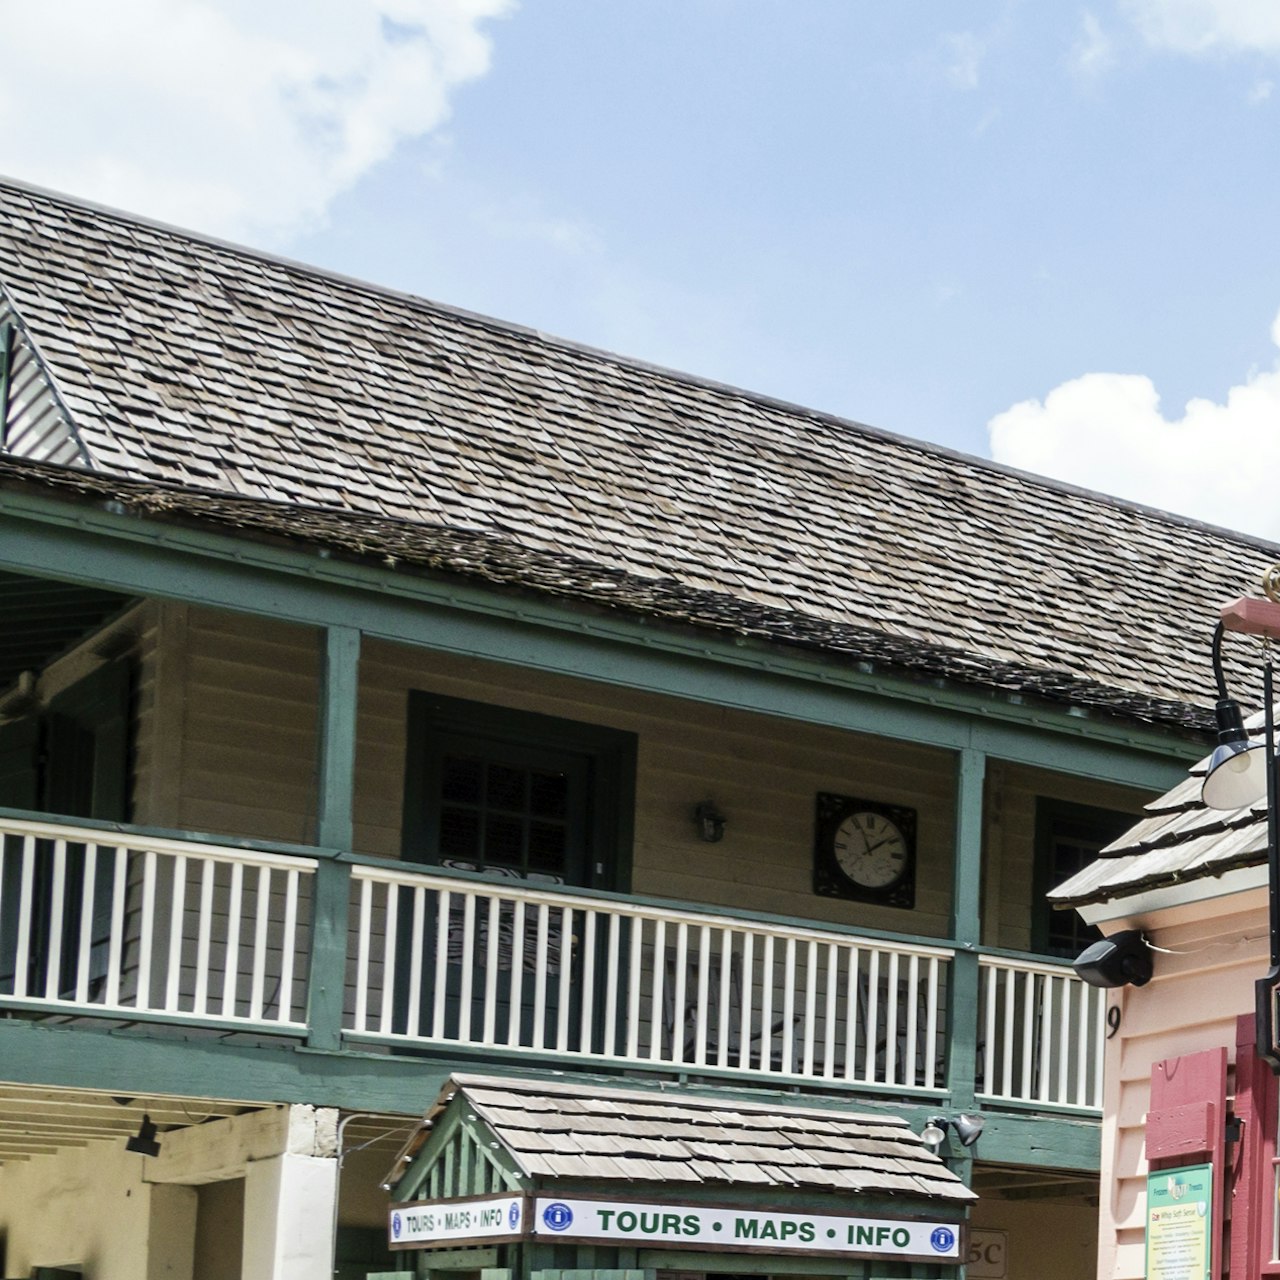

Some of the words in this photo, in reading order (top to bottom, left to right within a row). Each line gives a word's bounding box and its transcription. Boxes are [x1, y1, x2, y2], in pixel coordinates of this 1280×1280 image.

[1107, 1005, 1121, 1039] 9
[406, 1215, 434, 1233] TOURS
[445, 1212, 471, 1230] MAPS
[480, 1208, 502, 1227] INFO
[596, 1210, 700, 1236] TOURS
[734, 1218, 816, 1242] MAPS
[847, 1224, 911, 1248] INFO
